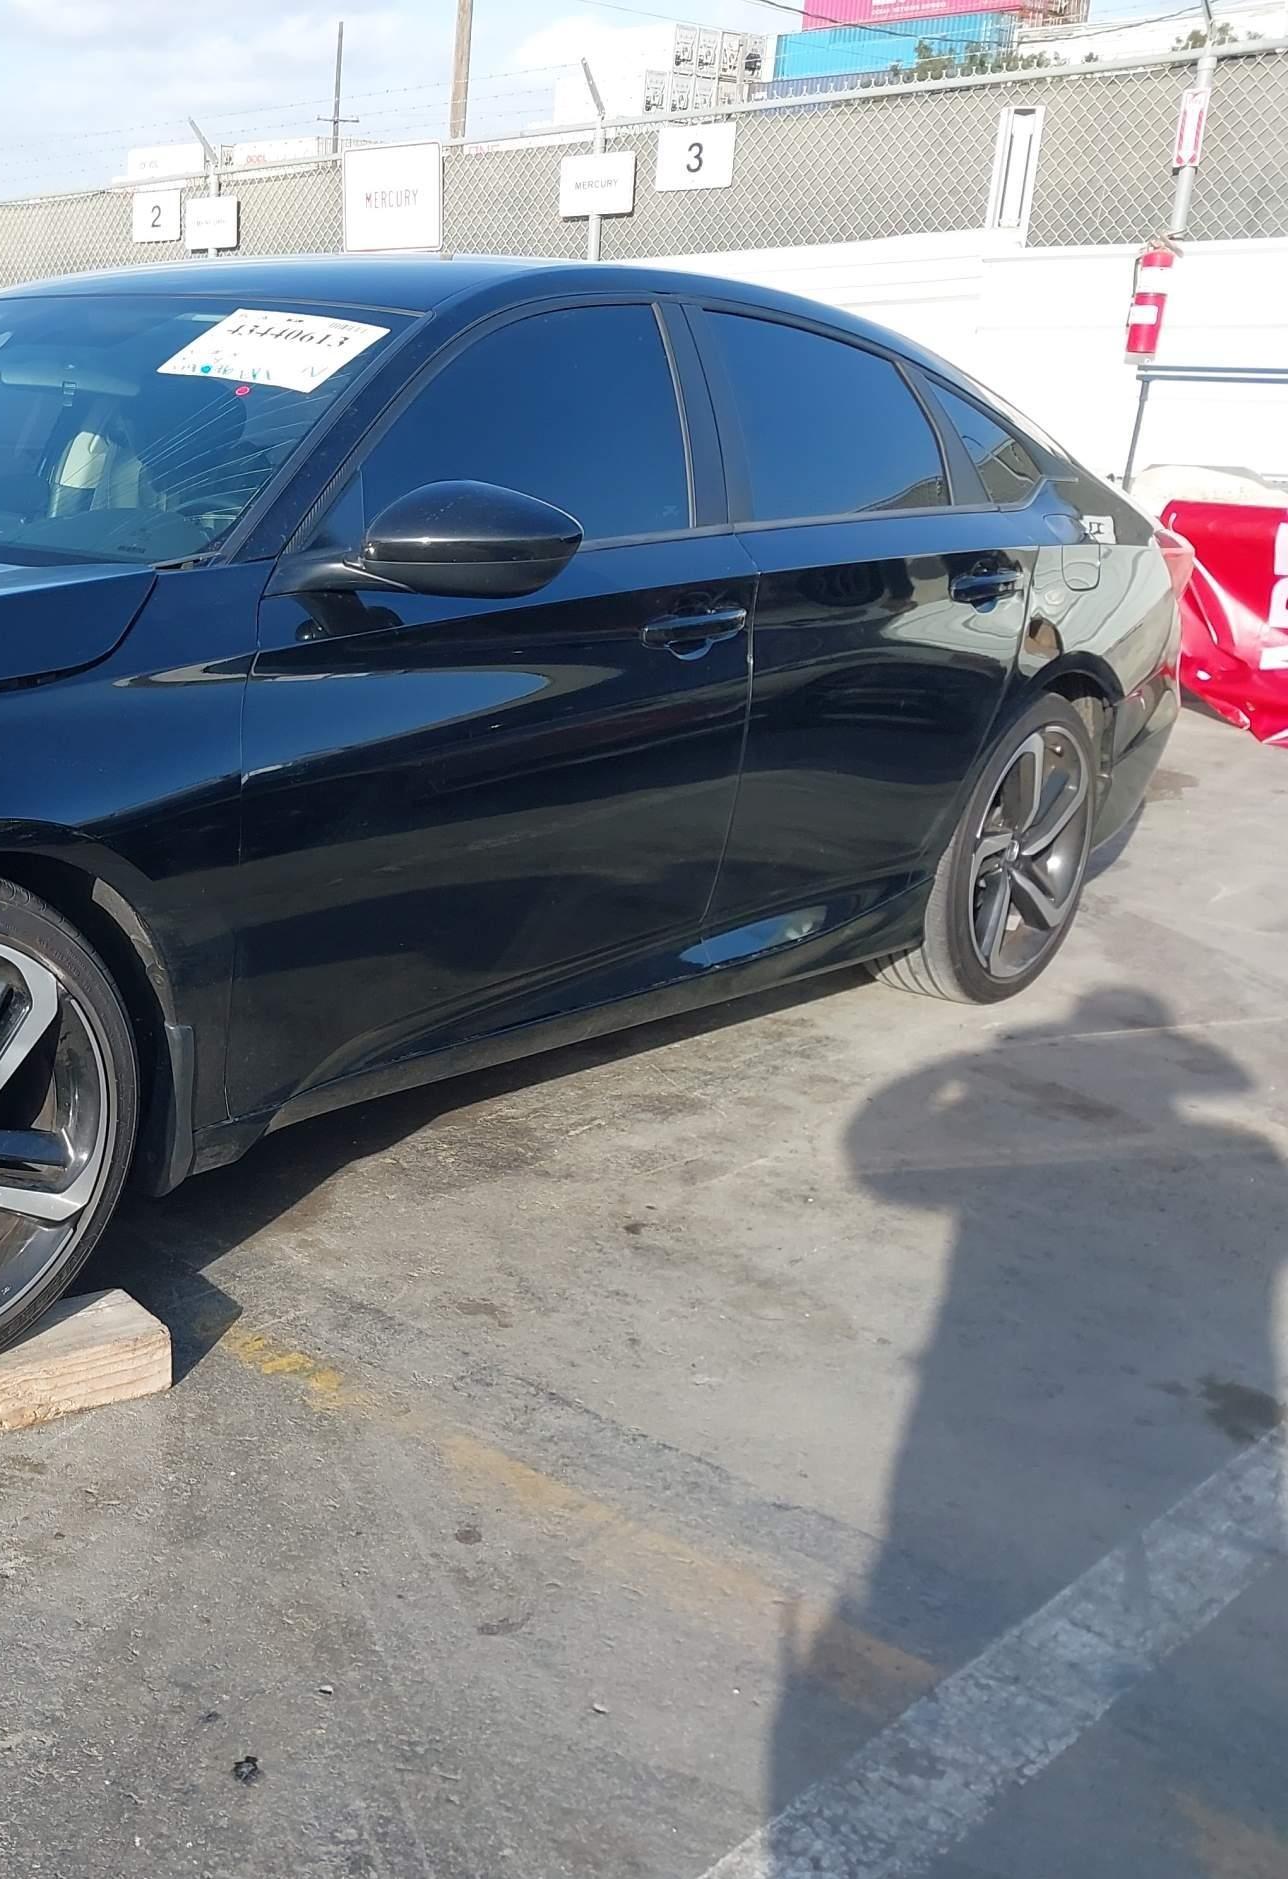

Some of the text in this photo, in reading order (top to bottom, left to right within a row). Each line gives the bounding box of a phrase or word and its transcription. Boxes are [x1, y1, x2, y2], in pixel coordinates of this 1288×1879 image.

[686, 142, 703, 173] 3
[574, 178, 619, 191] MERCURY
[365, 189, 419, 209] MERCURY
[151, 205, 162, 228] 2
